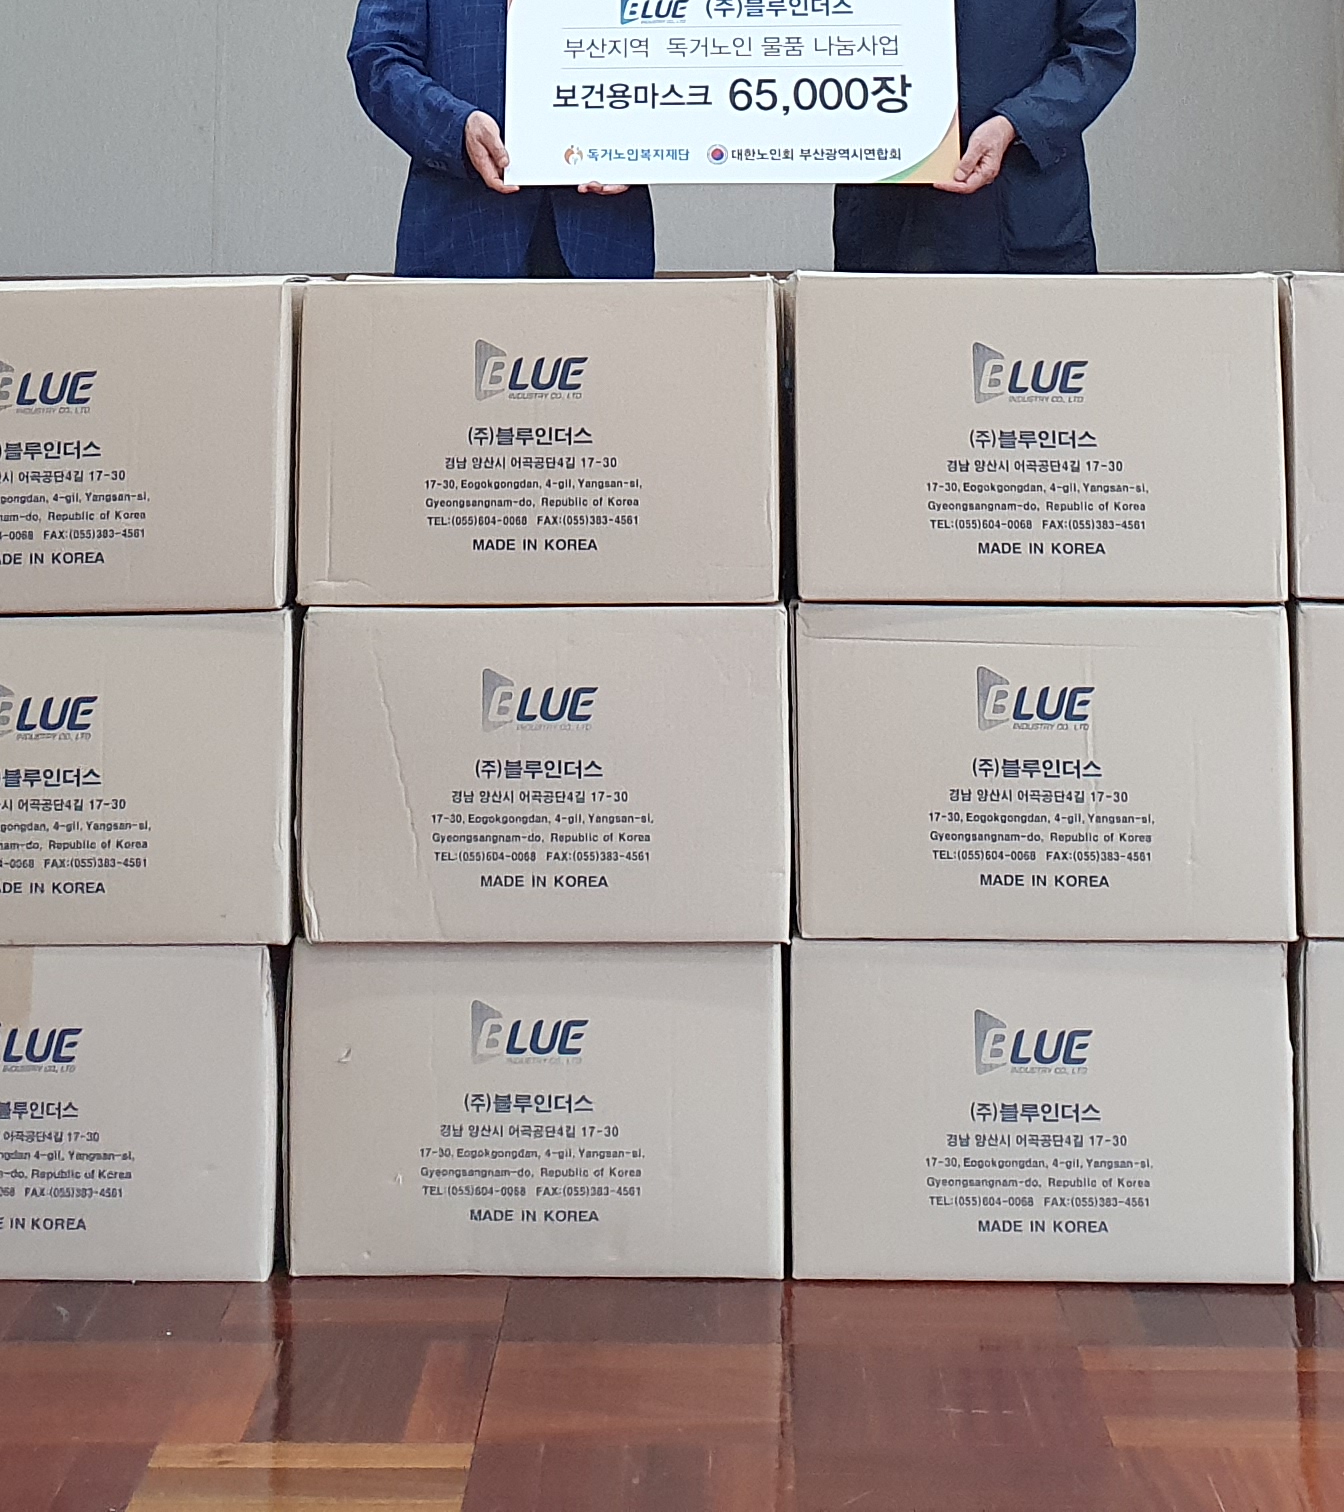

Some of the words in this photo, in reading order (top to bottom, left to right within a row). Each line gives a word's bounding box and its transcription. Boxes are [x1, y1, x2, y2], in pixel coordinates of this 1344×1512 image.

[563, 38, 649, 59] 부산지역
[666, 37, 752, 58] 독거노인
[761, 37, 804, 57] 물품
[814, 35, 899, 56] 나눔사업
[553, 82, 713, 110] 보건용마스크
[729, 75, 911, 116] 65,000장
[587, 148, 690, 162] 독거노인복지재단
[731, 148, 794, 161] 대한노인회
[799, 148, 901, 161] 부산광역시연합회
[477, 347, 589, 395] BLUE
[974, 350, 1090, 398] BLUE
[468, 426, 593, 446] (주)블루인더스
[969, 429, 1098, 449] (주)블루인더스
[1085, 460, 1124, 472] 17-30
[925, 482, 962, 494] 17-30,
[1045, 501, 1094, 513] Republic
[1098, 501, 1110, 512] of
[1113, 501, 1147, 512] Korea
[472, 539, 517, 552] MADE
[522, 539, 538, 552] IN
[543, 539, 599, 552] KOREA
[977, 541, 1023, 556] MADE
[1028, 541, 1045, 556] IN
[1050, 541, 1107, 556] KOREA
[28, 551, 45, 566] IN
[50, 551, 106, 566] KOREA
[484, 676, 599, 724] BLUE
[978, 674, 1096, 725] BLUE
[475, 759, 603, 780] (주)블루인더스
[972, 757, 1103, 778] (주)블루인더스
[1090, 790, 1129, 803] 17-30
[928, 812, 964, 824] 17-30,
[1049, 831, 1099, 843] Republic
[1103, 832, 1115, 842] of
[1119, 832, 1153, 843] Korea
[479, 873, 526, 889] MADE
[531, 873, 548, 889] IN
[553, 873, 609, 889] KOREA
[979, 872, 1026, 889] MADE
[1030, 872, 1048, 889] IN
[1053, 872, 1110, 889] KOREA
[473, 1008, 590, 1058] BLUE
[976, 1018, 1094, 1069] BLUE
[463, 1092, 595, 1115] (주)블루인더스
[969, 1101, 1102, 1124] (주)블루인더스
[1088, 1134, 1128, 1148] 17-30
[925, 1157, 961, 1169] 17-30,
[1047, 1177, 1098, 1189] Republic
[1101, 1177, 1113, 1188] of
[1117, 1177, 1151, 1188] Korea
[469, 1208, 515, 1223] MADE
[520, 1208, 537, 1223] IN
[543, 1208, 600, 1223] KOREA
[977, 1218, 1024, 1234] MADE
[1029, 1218, 1046, 1234] IN
[1052, 1218, 1109, 1234] KOREA
